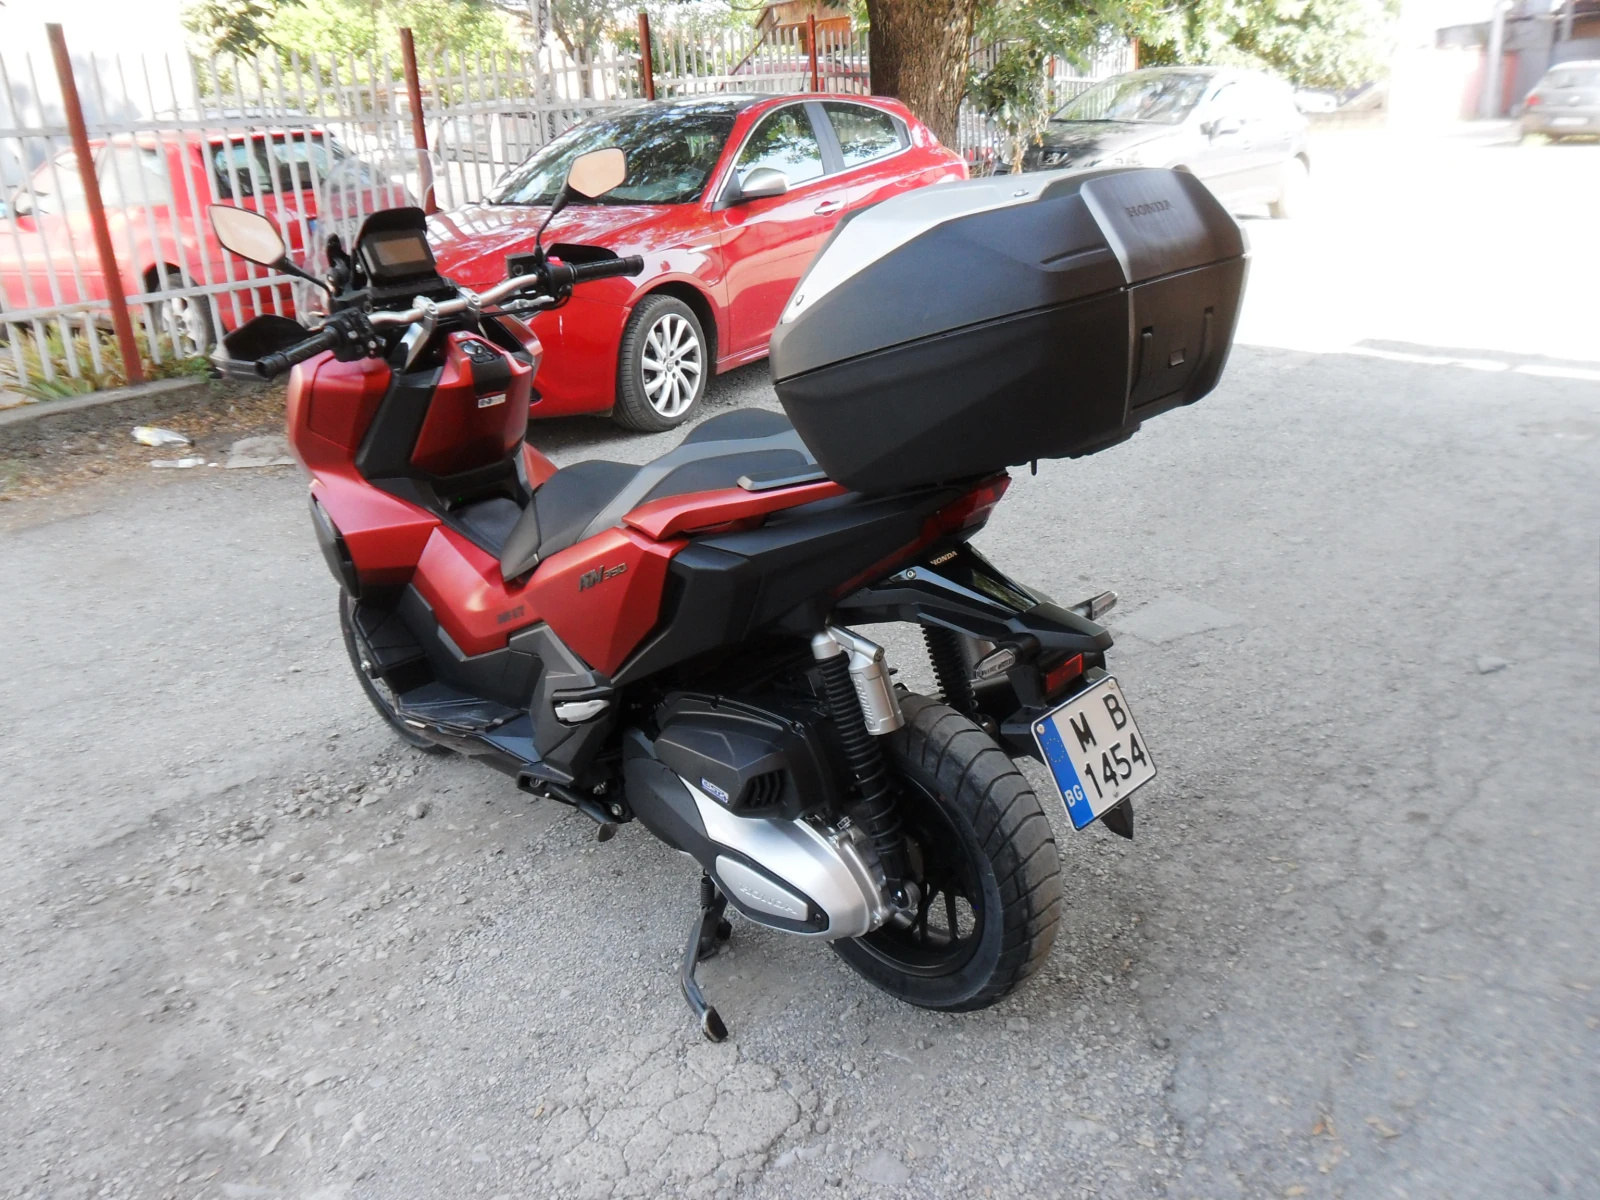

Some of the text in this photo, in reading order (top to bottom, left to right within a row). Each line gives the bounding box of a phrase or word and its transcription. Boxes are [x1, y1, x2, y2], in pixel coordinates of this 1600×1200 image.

[1125, 200, 1174, 217] HONDA
[929, 550, 958, 566] HONDA
[604, 562, 628, 580] 350
[1069, 694, 1127, 753] M B
[1084, 733, 1147, 799] 1454
[1064, 784, 1084, 807] BG
